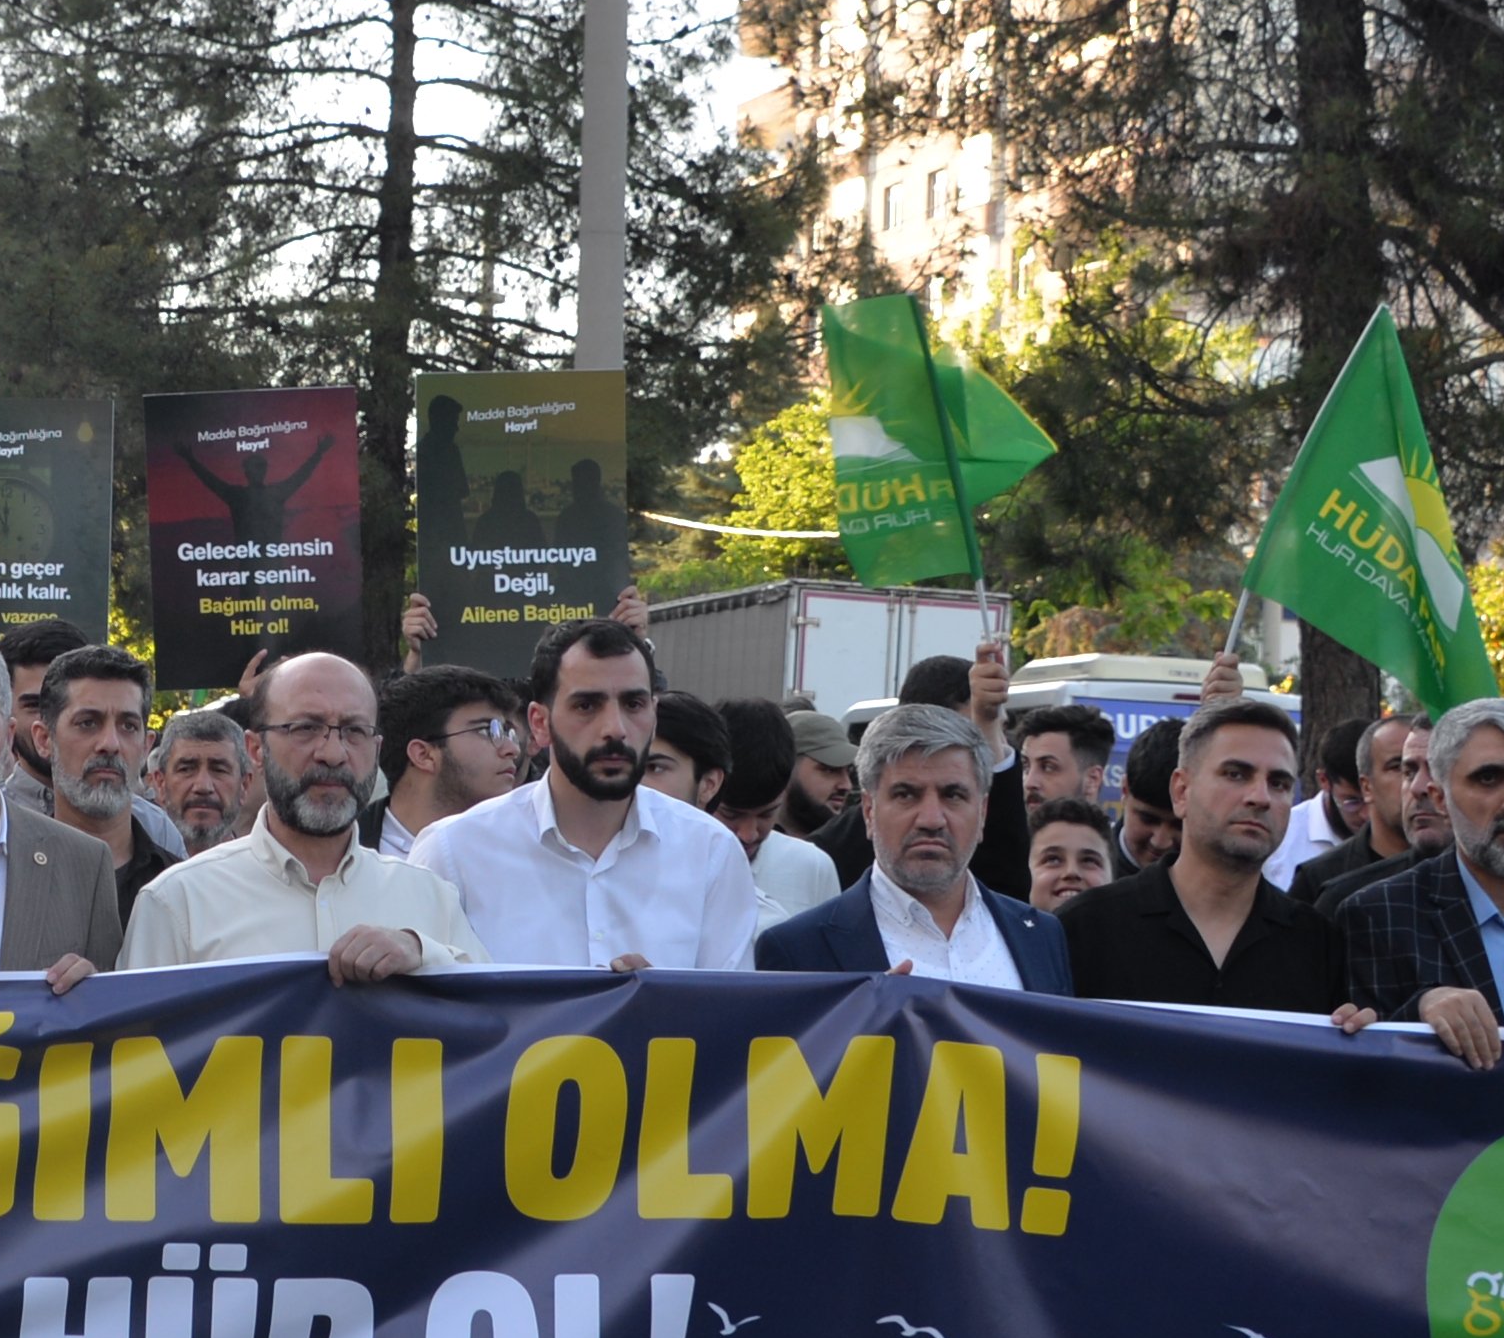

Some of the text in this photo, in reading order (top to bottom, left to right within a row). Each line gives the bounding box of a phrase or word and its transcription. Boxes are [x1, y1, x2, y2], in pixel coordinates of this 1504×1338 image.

[467, 401, 576, 422] Madde Bağımlılığına
[198, 420, 308, 442] Madde Bağımlılığına
[505, 419, 537, 433] Hayır!
[236, 438, 269, 452] Hayır!
[177, 538, 333, 561] Gelecek sensin
[450, 545, 597, 570] Uyuşturucuya
[10, 562, 64, 579] geçer
[197, 566, 316, 586] karar senin.
[27, 583, 71, 601] kalır.
[494, 572, 555, 596] Değil,
[1354, 559, 1409, 615] DAVA
[199, 595, 319, 616] Bağımlı olma,
[461, 603, 594, 625] Ailene Bağlan!
[230, 618, 289, 635] Hür ol!
[503, 1034, 1083, 1238] OLMA!
